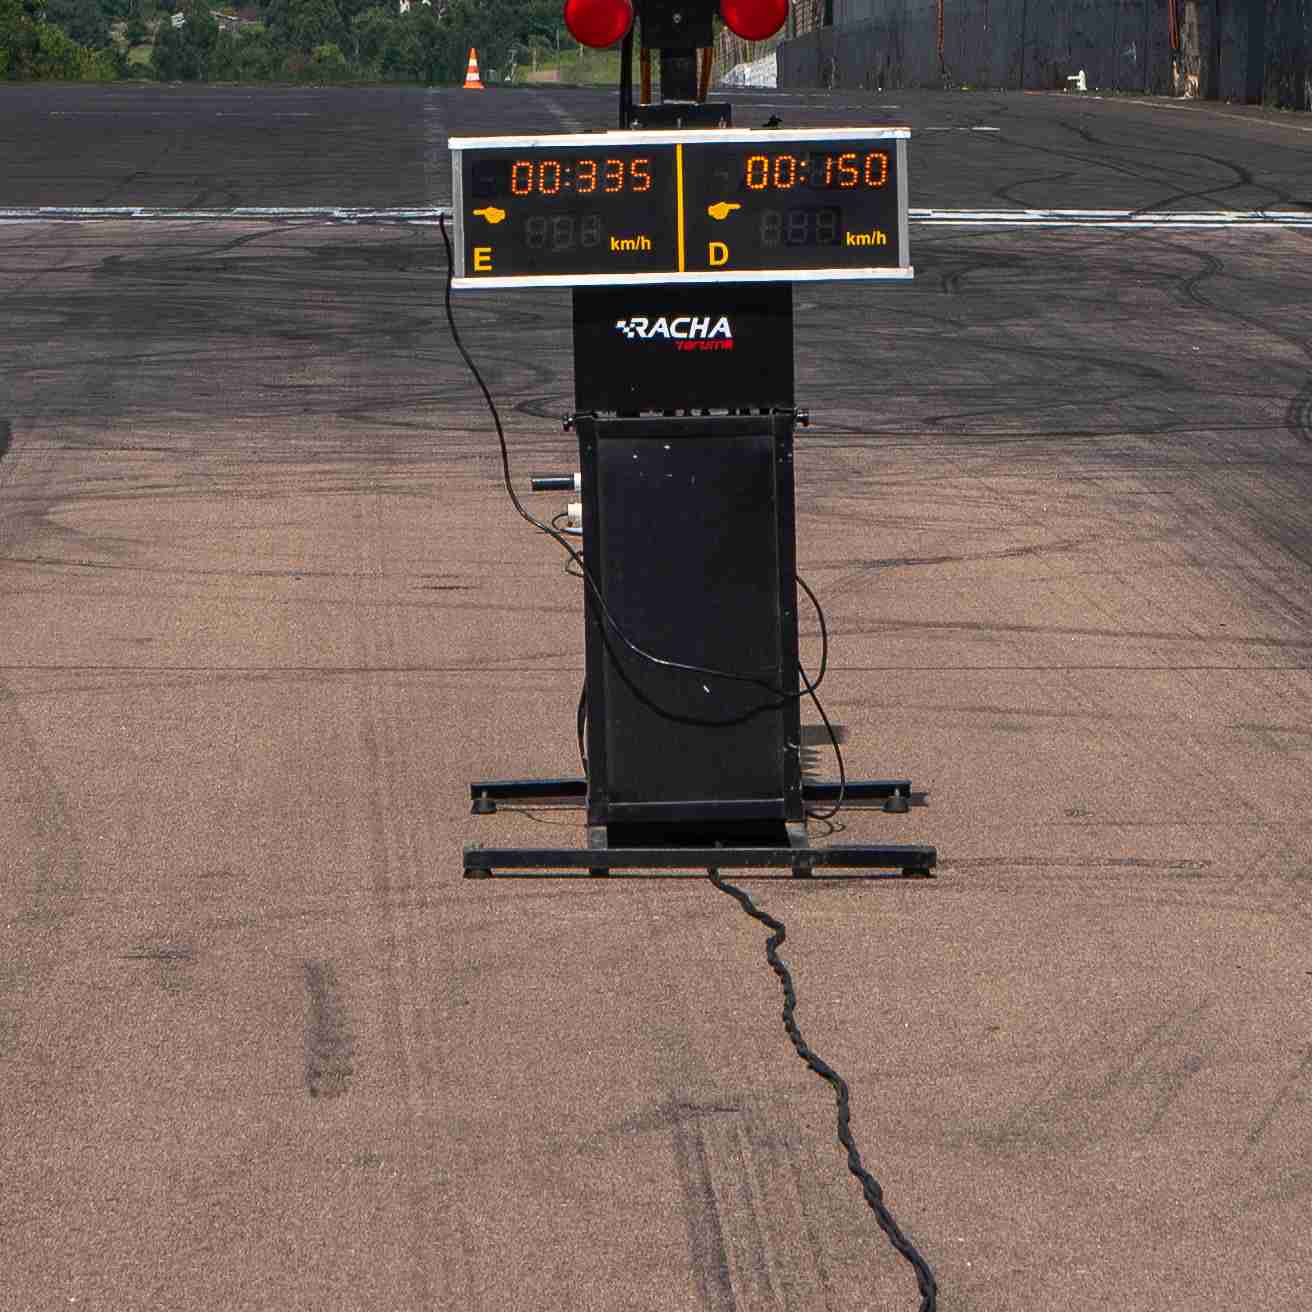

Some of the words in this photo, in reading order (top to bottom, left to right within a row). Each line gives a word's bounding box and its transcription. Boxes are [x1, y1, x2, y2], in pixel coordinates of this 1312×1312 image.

[512, 159, 652, 195] 00:335
[745, 152, 888, 190] 00:150
[610, 235, 652, 251] km/h
[846, 229, 888, 246] km/h
[473, 247, 493, 272] E
[708, 241, 730, 267] D
[627, 317, 733, 338] RACHA
